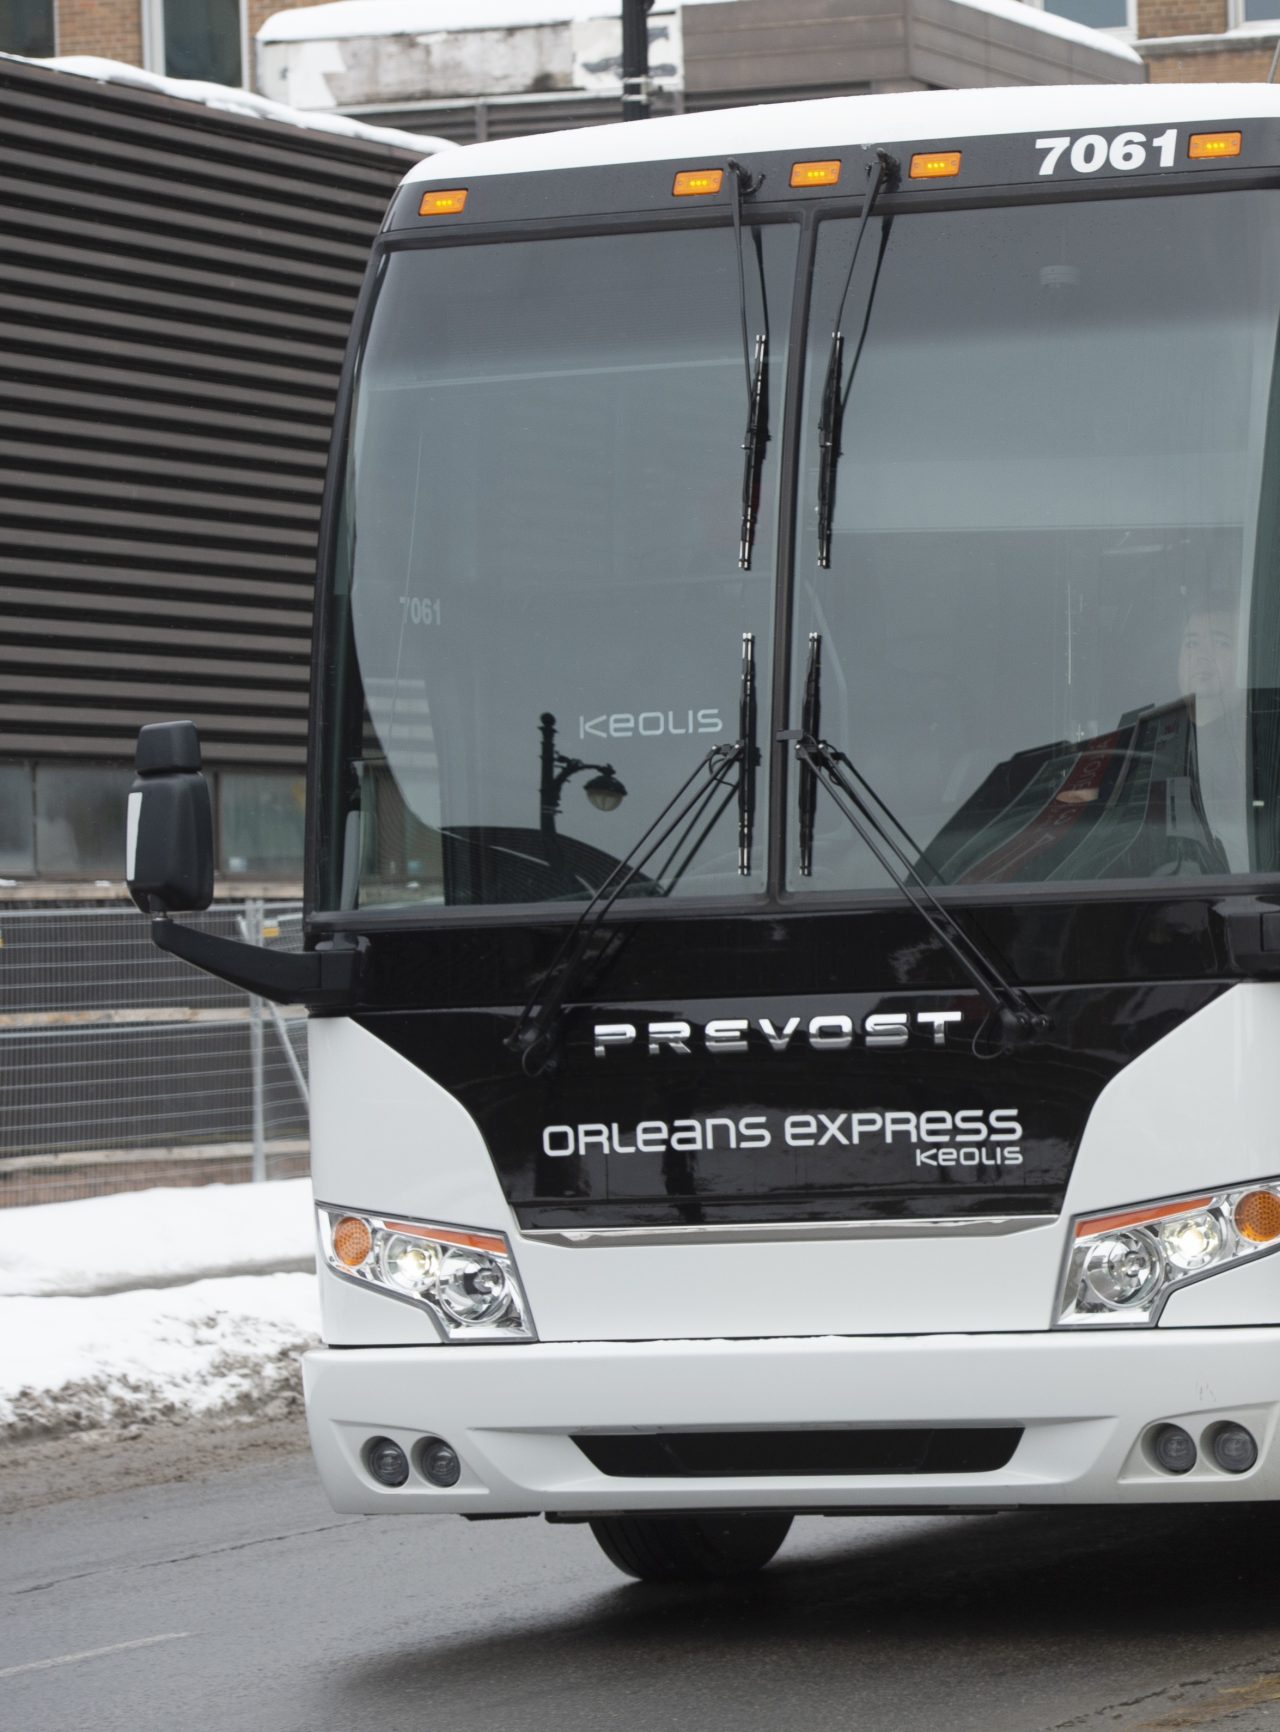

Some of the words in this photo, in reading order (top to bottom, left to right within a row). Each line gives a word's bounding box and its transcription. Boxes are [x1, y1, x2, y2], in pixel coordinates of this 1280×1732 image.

[1033, 128, 1178, 176] 7061
[400, 596, 441, 625] 7061
[593, 1011, 962, 1057] PREVOST
